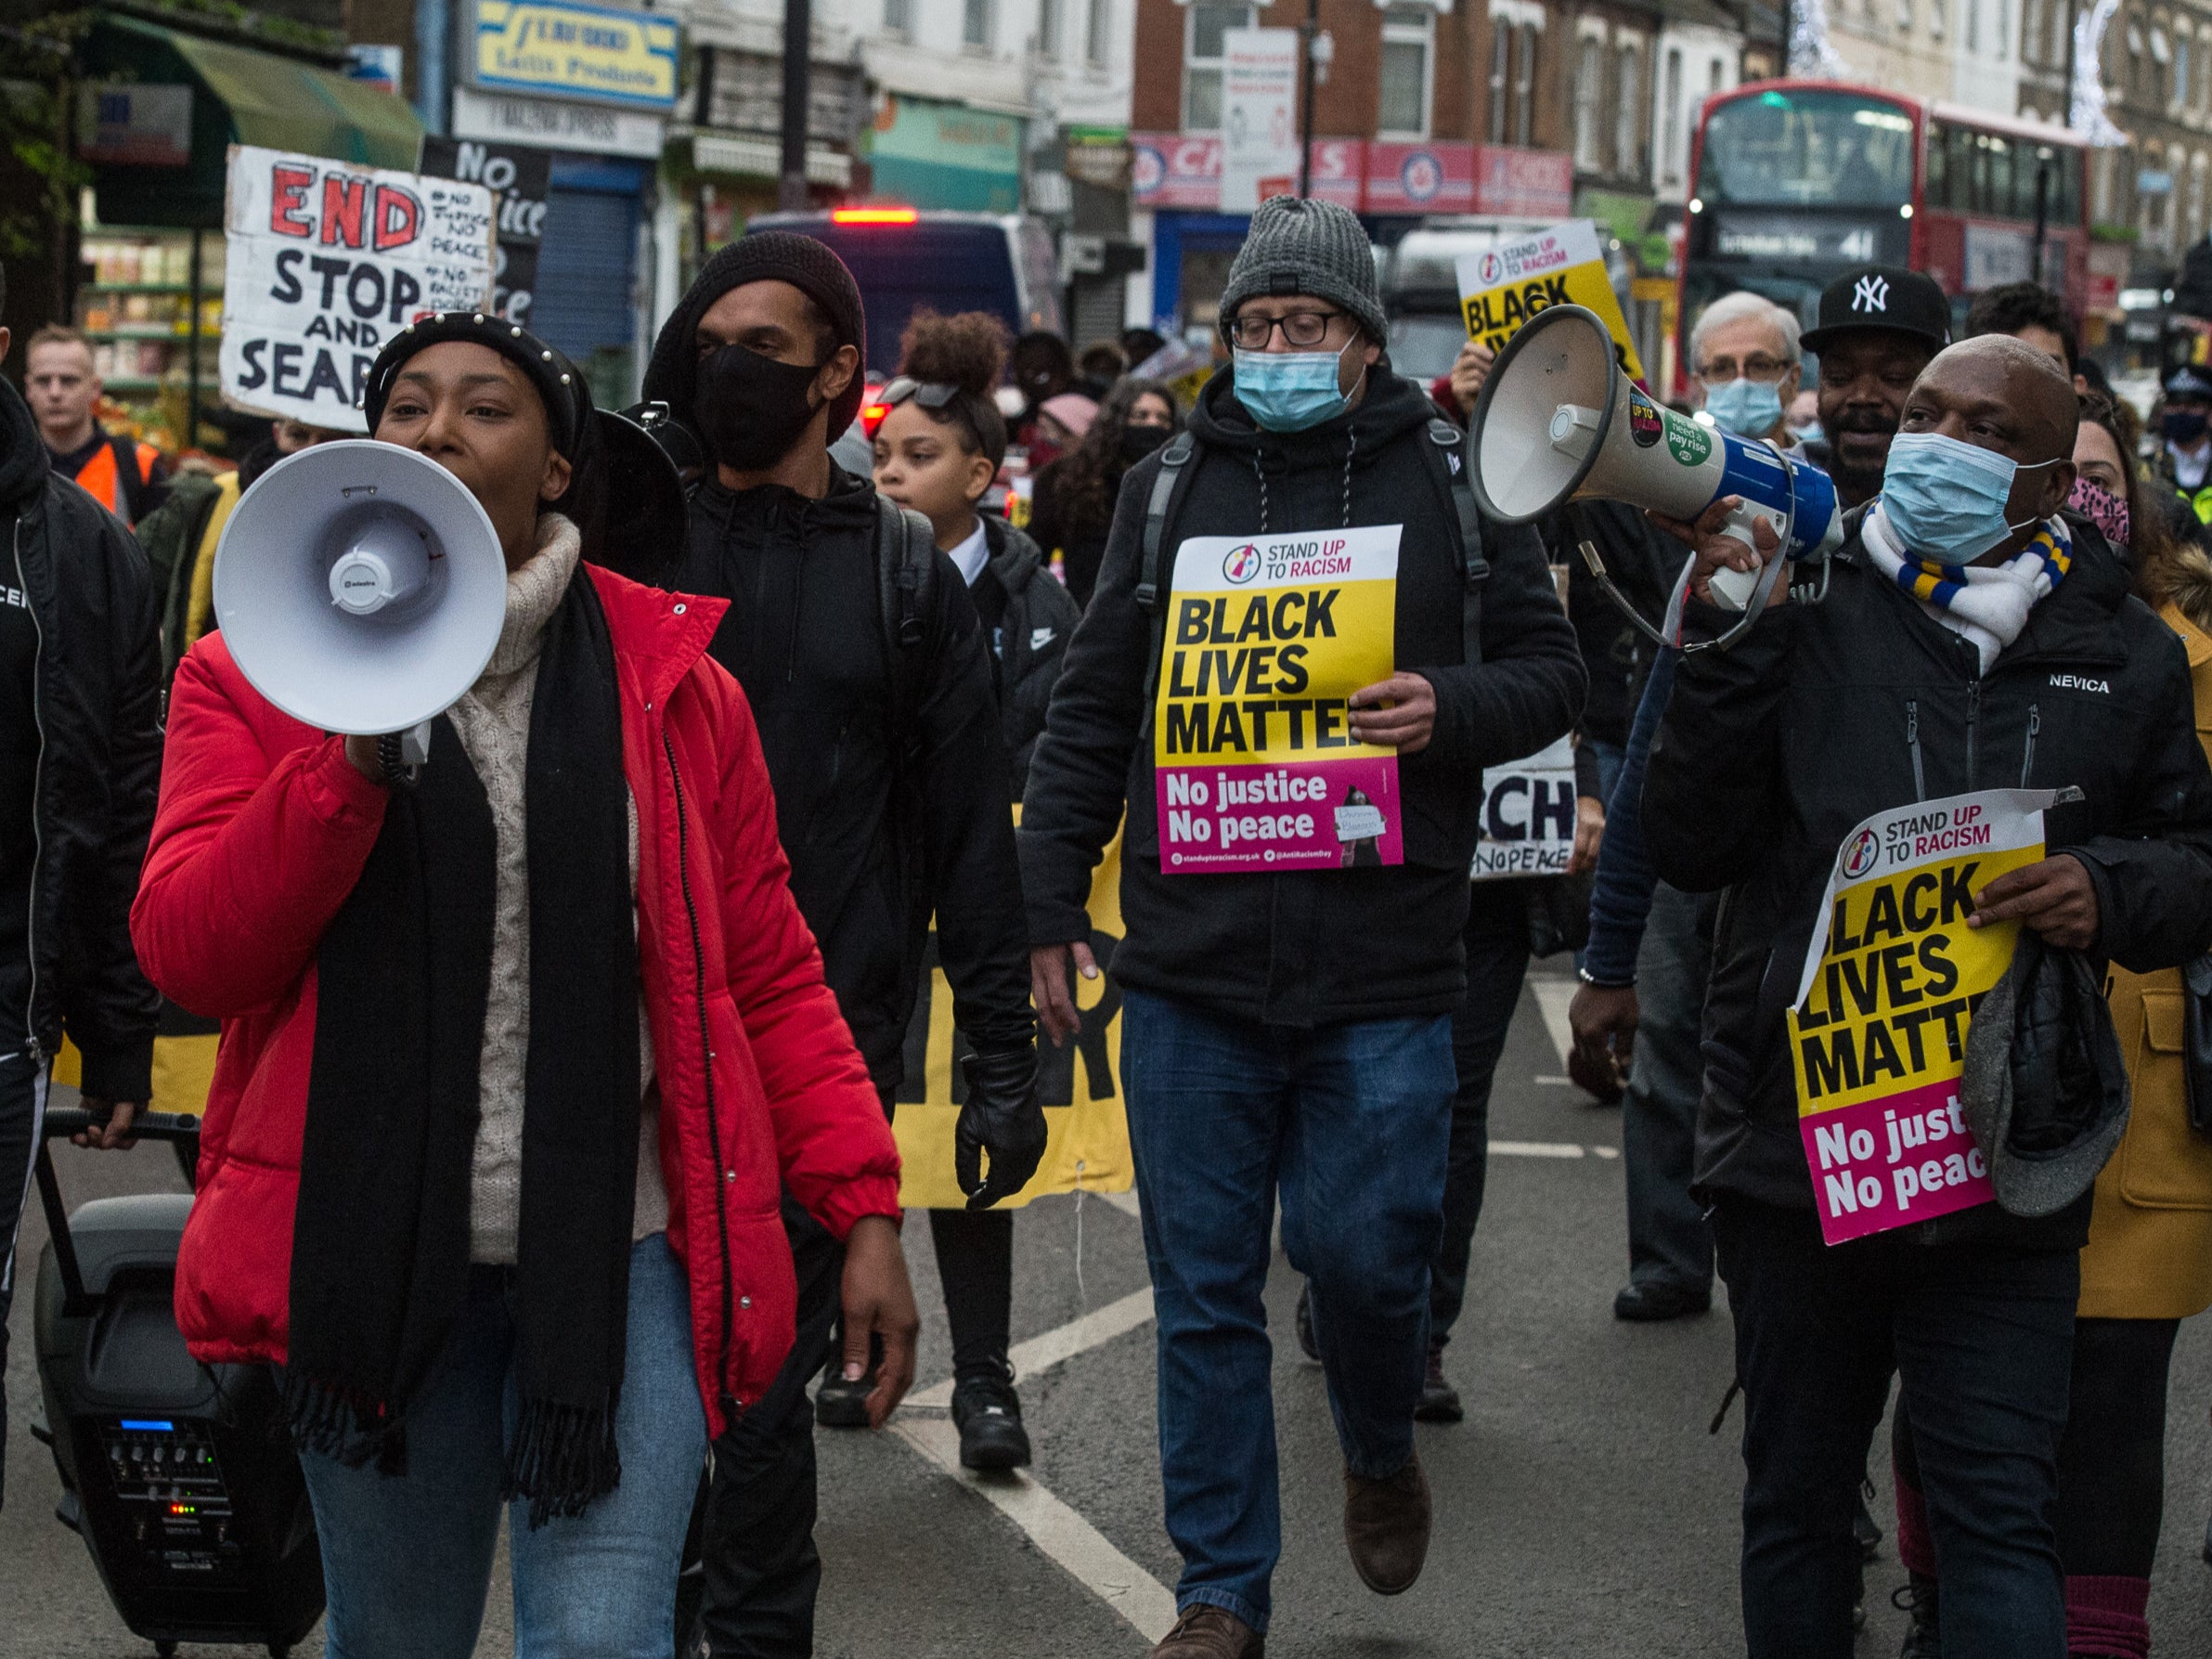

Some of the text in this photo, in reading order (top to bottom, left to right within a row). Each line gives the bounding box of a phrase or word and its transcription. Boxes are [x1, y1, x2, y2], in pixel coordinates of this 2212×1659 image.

[271, 160, 426, 252] END
[1503, 237, 1558, 262] STAND UP
[1506, 250, 1568, 276] TO RACISM
[1839, 229, 1873, 262] 41
[270, 249, 420, 323] STOP
[304, 315, 379, 348] AND
[1633, 405, 1654, 420] UP TO
[1673, 423, 1695, 439] need
[1669, 432, 1707, 455] pay rise
[1267, 557, 1352, 580] TO RACISM
[1268, 539, 1345, 562] STAND UP
[1176, 590, 1341, 645] BLACK
[1169, 644, 1309, 698] LIVES
[2050, 674, 2110, 693] NEVICA
[1167, 770, 1326, 812] No justice
[1169, 810, 1314, 849] No peace
[1886, 805, 1982, 842] STAND UP
[1184, 852, 1261, 862] standuptoracism.org.uk
[1886, 823, 1990, 864] TO RACISM
[1822, 862, 1981, 959] LACK
[1801, 990, 1991, 1099] MATT
[1814, 1095, 1967, 1171] No just
[1824, 1147, 1987, 1218] No peac
